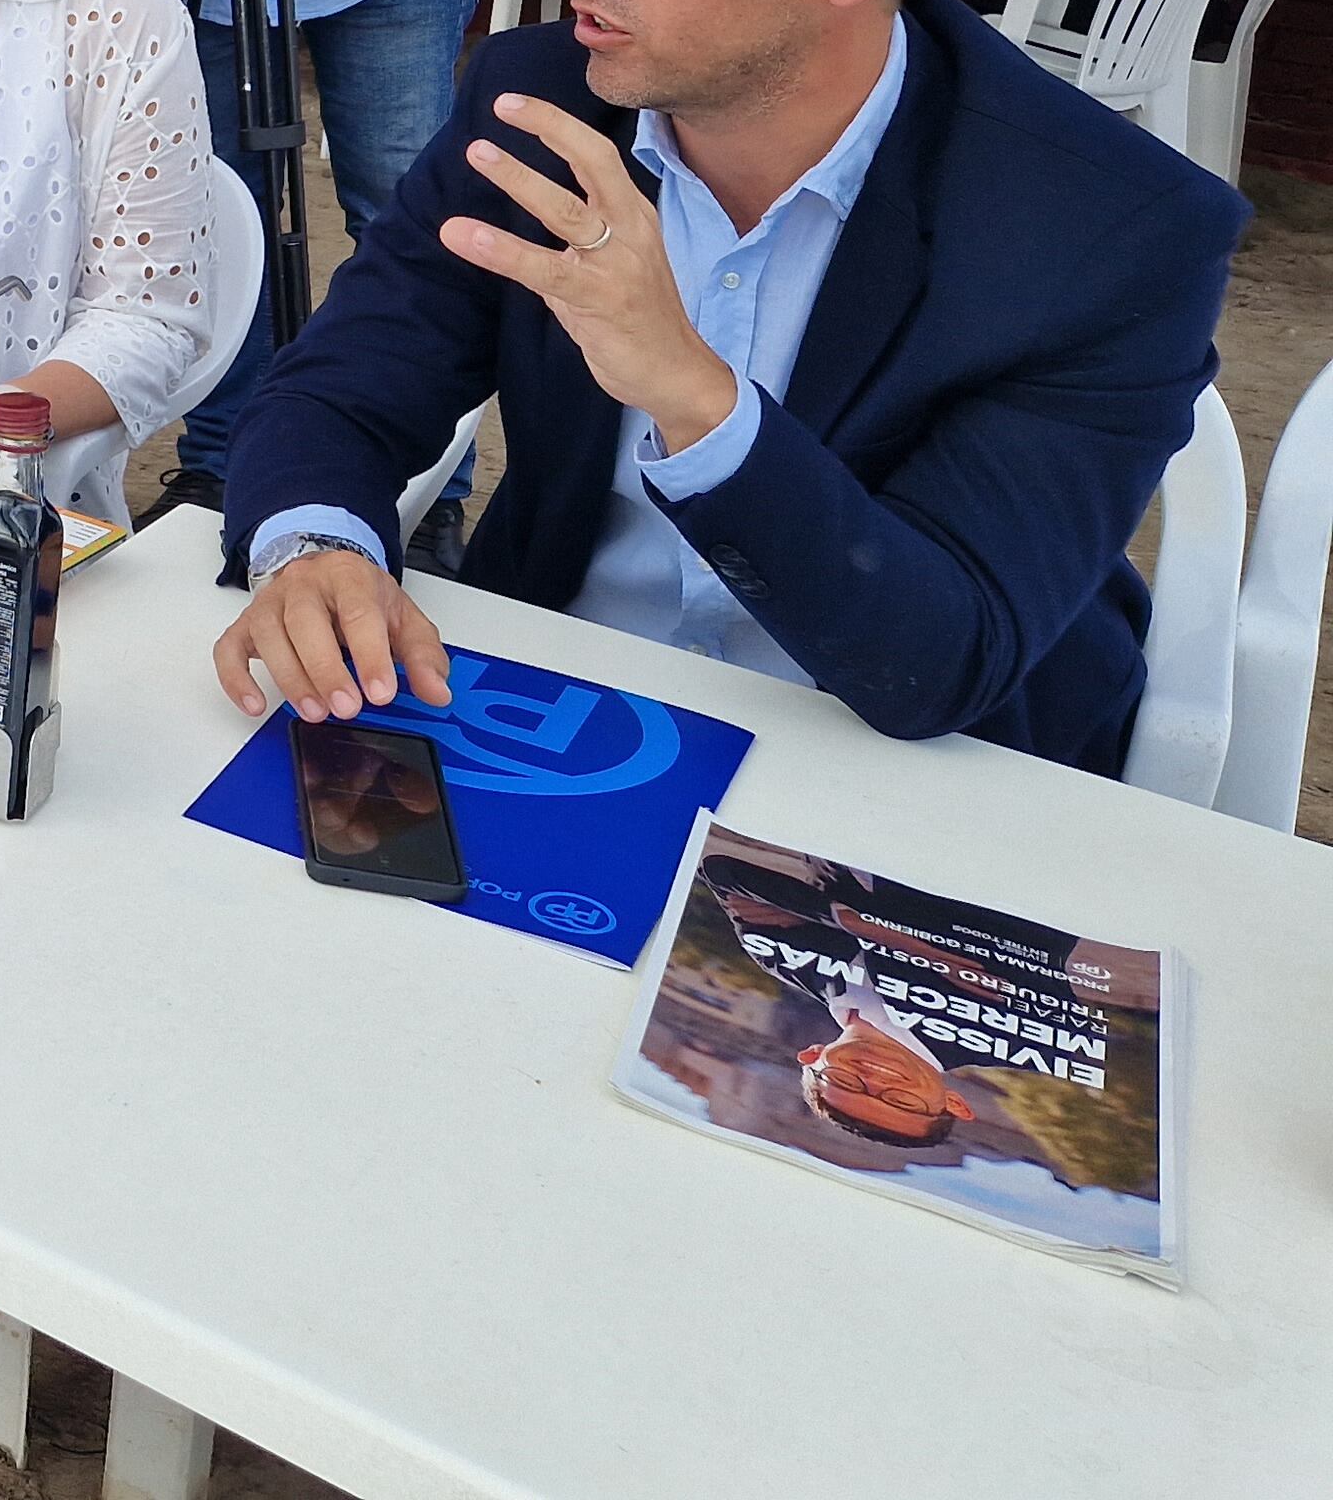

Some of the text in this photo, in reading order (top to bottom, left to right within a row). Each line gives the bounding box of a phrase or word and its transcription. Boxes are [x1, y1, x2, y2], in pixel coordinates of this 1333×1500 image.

[857, 937, 1110, 1022] TRIGUERO COSTA
[859, 912, 1110, 994] PROGRAMA DE GOBIERNO
[741, 933, 1108, 1062] MERECE MÁS
[1001, 994, 1108, 1035] RAFAEL
[884, 1004, 1106, 1090] EIVISSA
